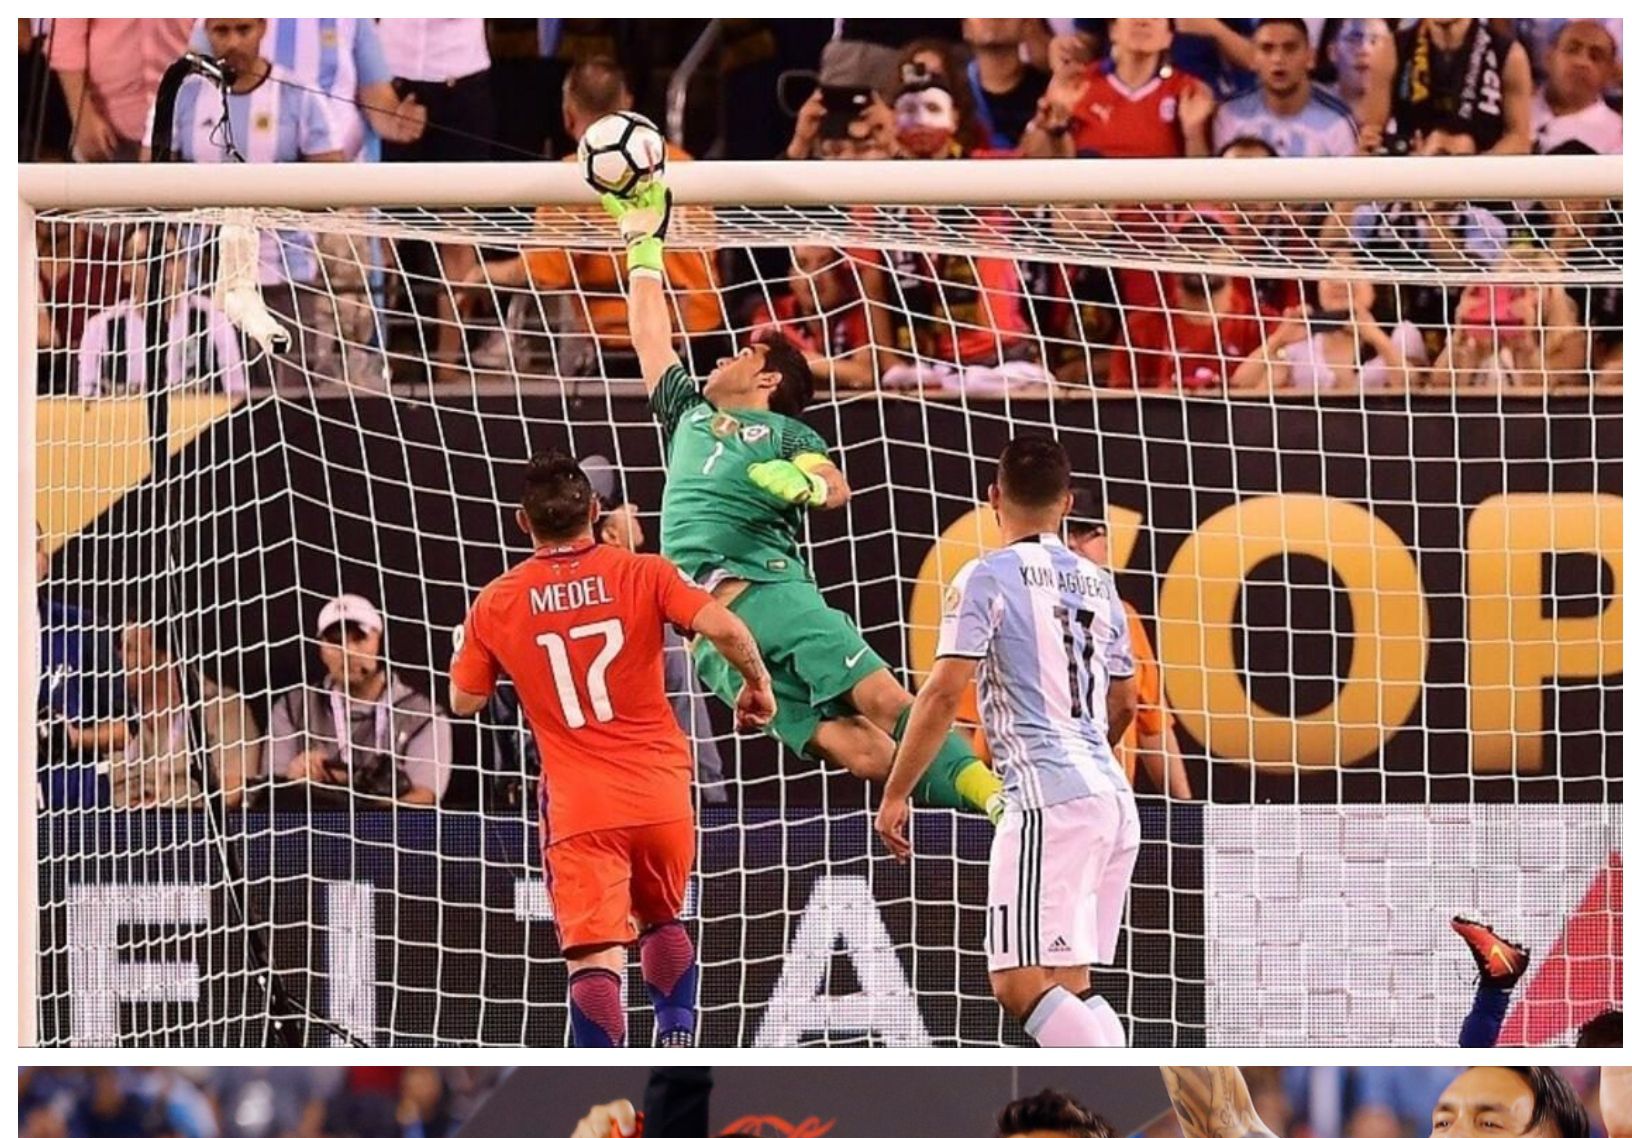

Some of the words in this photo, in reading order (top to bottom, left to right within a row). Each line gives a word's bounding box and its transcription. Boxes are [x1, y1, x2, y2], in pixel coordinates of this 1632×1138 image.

[529, 576, 614, 615] MEDEL
[1019, 566, 1054, 588] KUN
[536, 618, 626, 729] 17
[1053, 605, 1096, 719] 11
